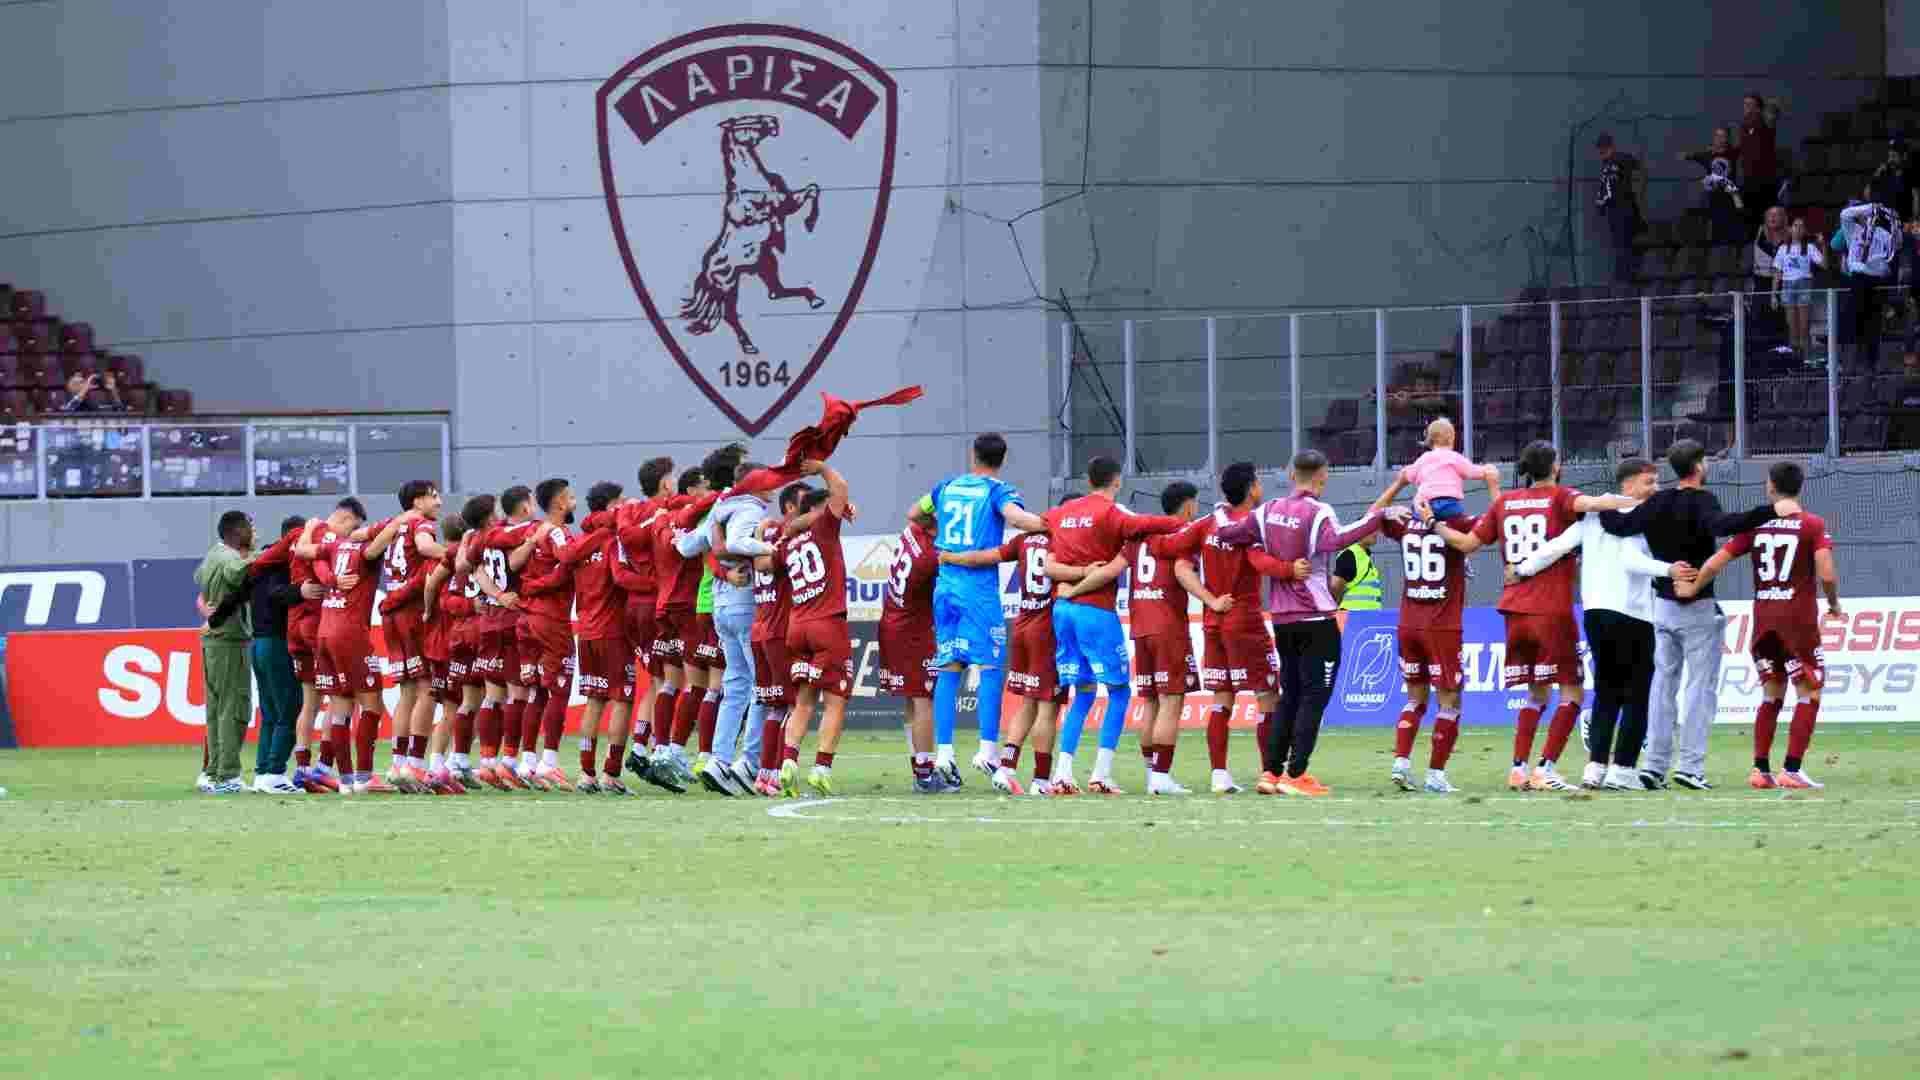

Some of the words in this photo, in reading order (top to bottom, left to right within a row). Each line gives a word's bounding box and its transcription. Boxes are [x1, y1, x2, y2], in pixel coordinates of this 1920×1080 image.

[638, 54, 854, 125] ΛΑΡΙΣΑ
[719, 360, 791, 388] 1964
[944, 500, 975, 545] 21
[1503, 513, 1548, 564] 88
[786, 541, 826, 592] 20
[1137, 540, 1156, 583] 6
[1402, 533, 1446, 582] 66
[1754, 533, 1799, 582] 37
